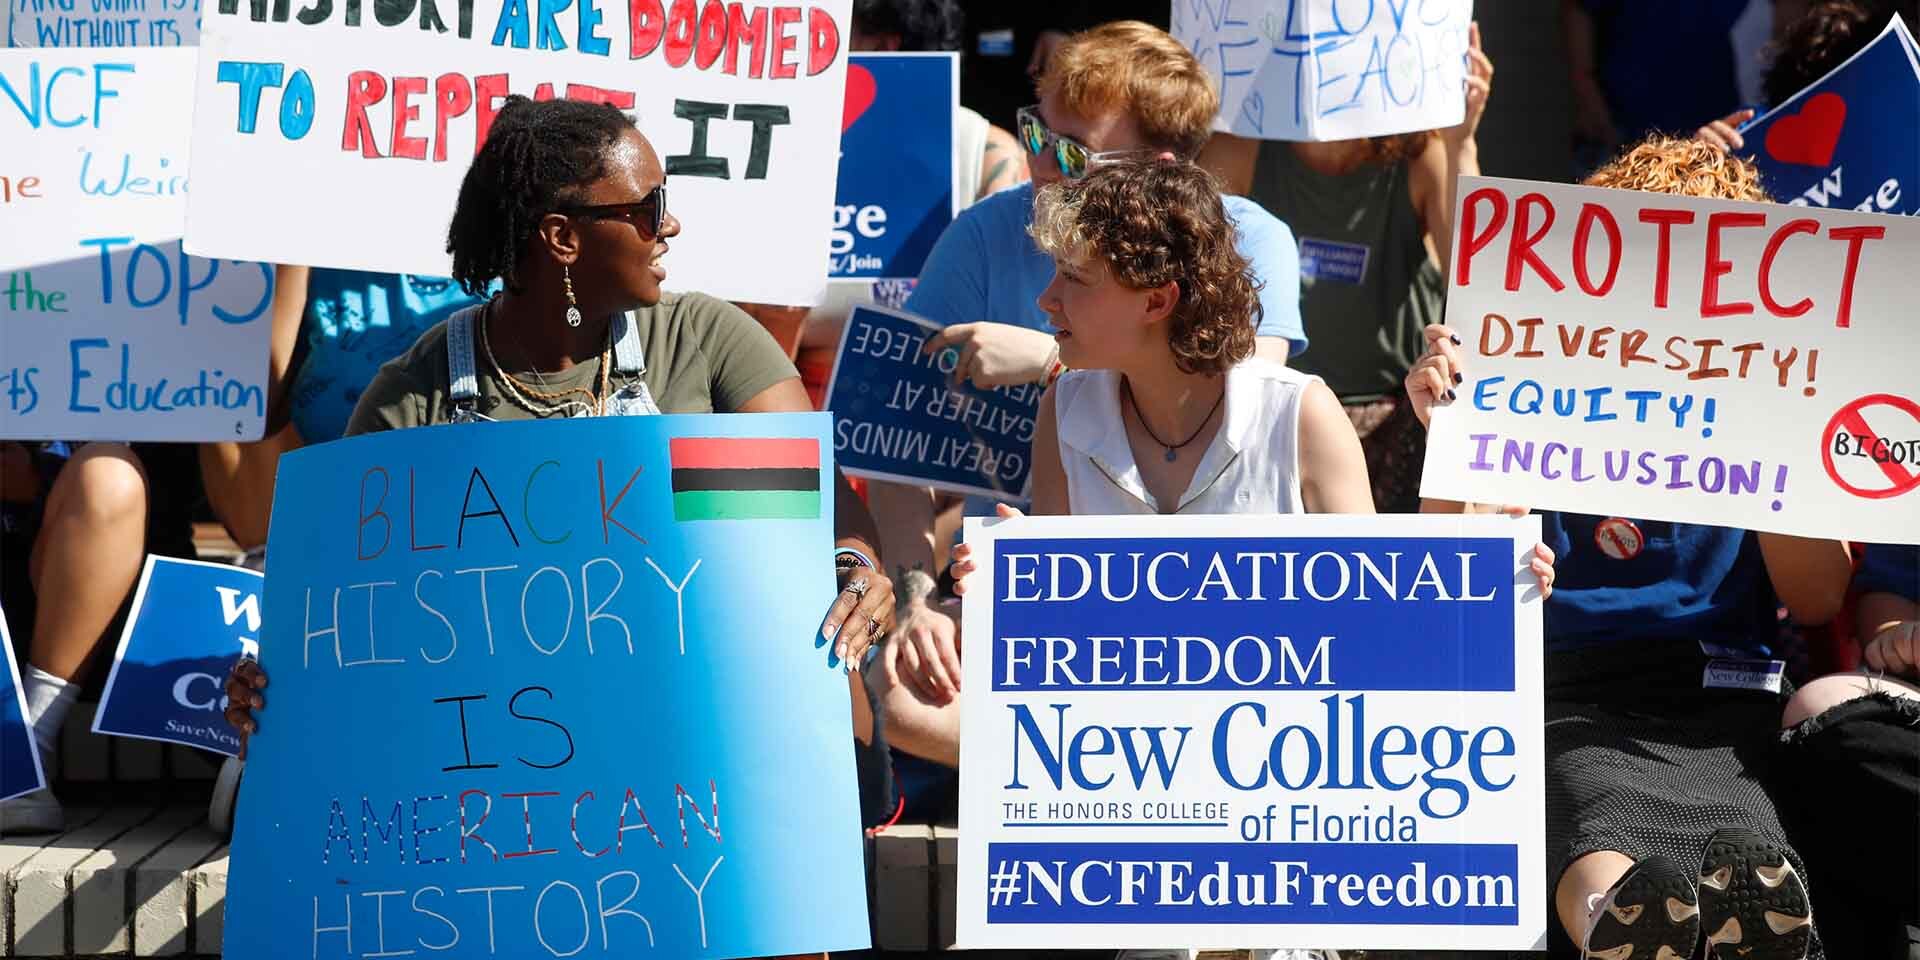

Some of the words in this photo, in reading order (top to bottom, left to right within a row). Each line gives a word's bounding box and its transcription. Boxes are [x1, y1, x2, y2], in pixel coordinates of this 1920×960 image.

[36, 16, 141, 48] WITHOUT
[149, 18, 182, 48] ITS
[491, 0, 612, 57] ARE
[627, 0, 840, 79] DOOMED
[0, 62, 136, 128] NCF
[217, 61, 315, 140] TO
[341, 69, 636, 162] REPE
[665, 98, 791, 180] IT
[78, 152, 188, 197] Weir
[1457, 188, 1886, 327] PROTECT
[2, 272, 68, 313] the
[68, 338, 264, 417] Education
[1479, 313, 1819, 397] DIVERSITY!
[886, 379, 925, 411] AT
[926, 387, 1036, 443] GATHER
[1473, 376, 1716, 437] EQUITY!
[834, 418, 931, 463] MINDS
[932, 442, 1023, 480] GREAT
[1469, 433, 1788, 511] INCLUSION!
[358, 459, 648, 560] BLACK
[1001, 551, 1497, 602] EDUCATIONAL
[304, 558, 701, 669] HISTORY
[1000, 636, 1336, 686] FREEDOM
[434, 687, 574, 771] IS
[1003, 703, 1193, 791] New
[1211, 693, 1517, 818] College
[324, 779, 722, 865] AMERICAN
[1003, 803, 1038, 819] THE
[1048, 803, 1132, 819] HONORS
[1142, 803, 1229, 819] COLLEGE
[1240, 804, 1277, 842] of
[1290, 805, 1417, 842] Florida
[313, 856, 723, 960] HISTORY
[990, 860, 1517, 908] #NCFEduFreedom
